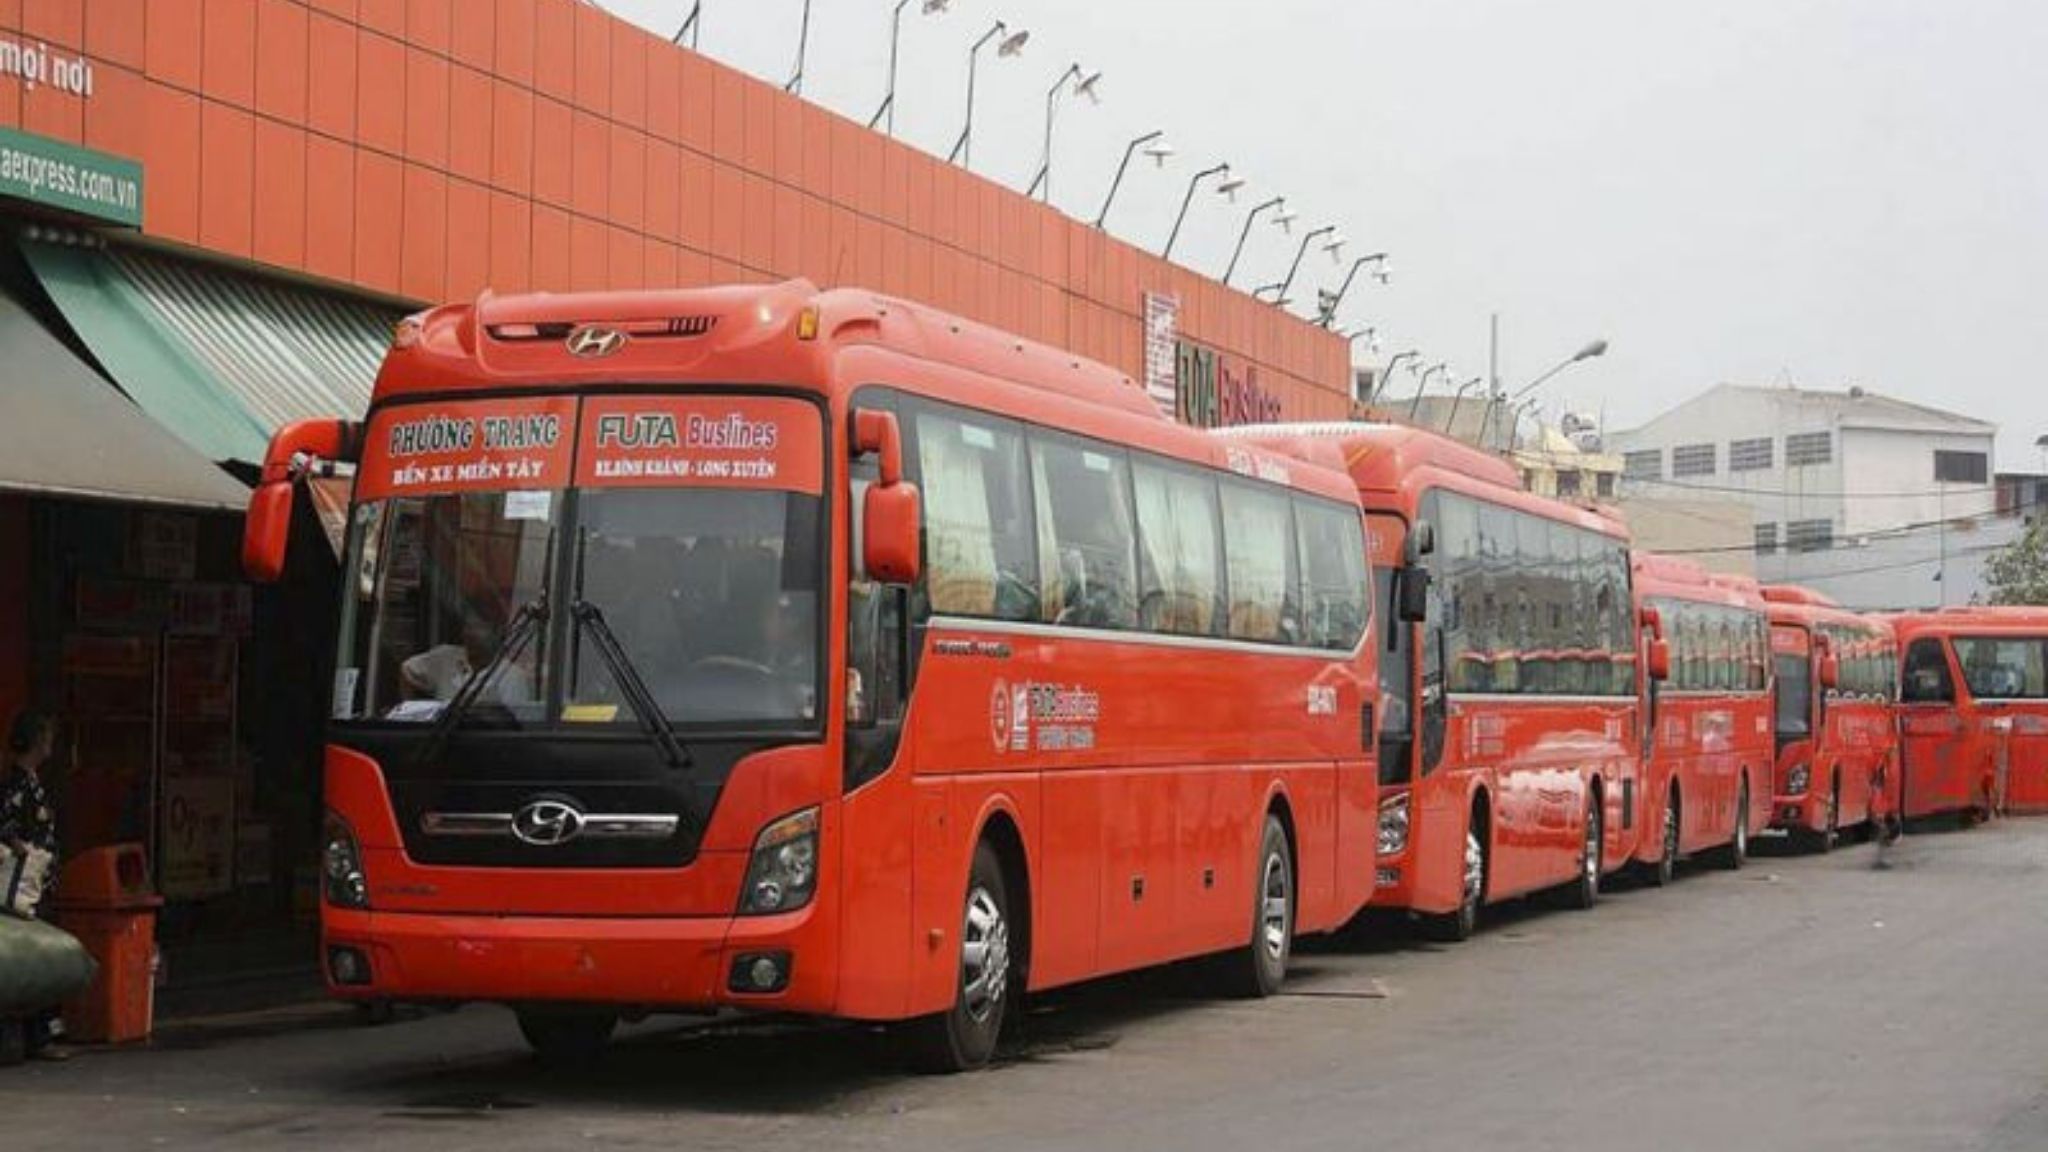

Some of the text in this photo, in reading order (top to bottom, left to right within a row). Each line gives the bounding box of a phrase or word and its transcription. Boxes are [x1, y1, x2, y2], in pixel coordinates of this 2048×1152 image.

[482, 413, 560, 449] TRANG
[597, 412, 776, 449] FUTA Buslines
[430, 465, 454, 482] XE
